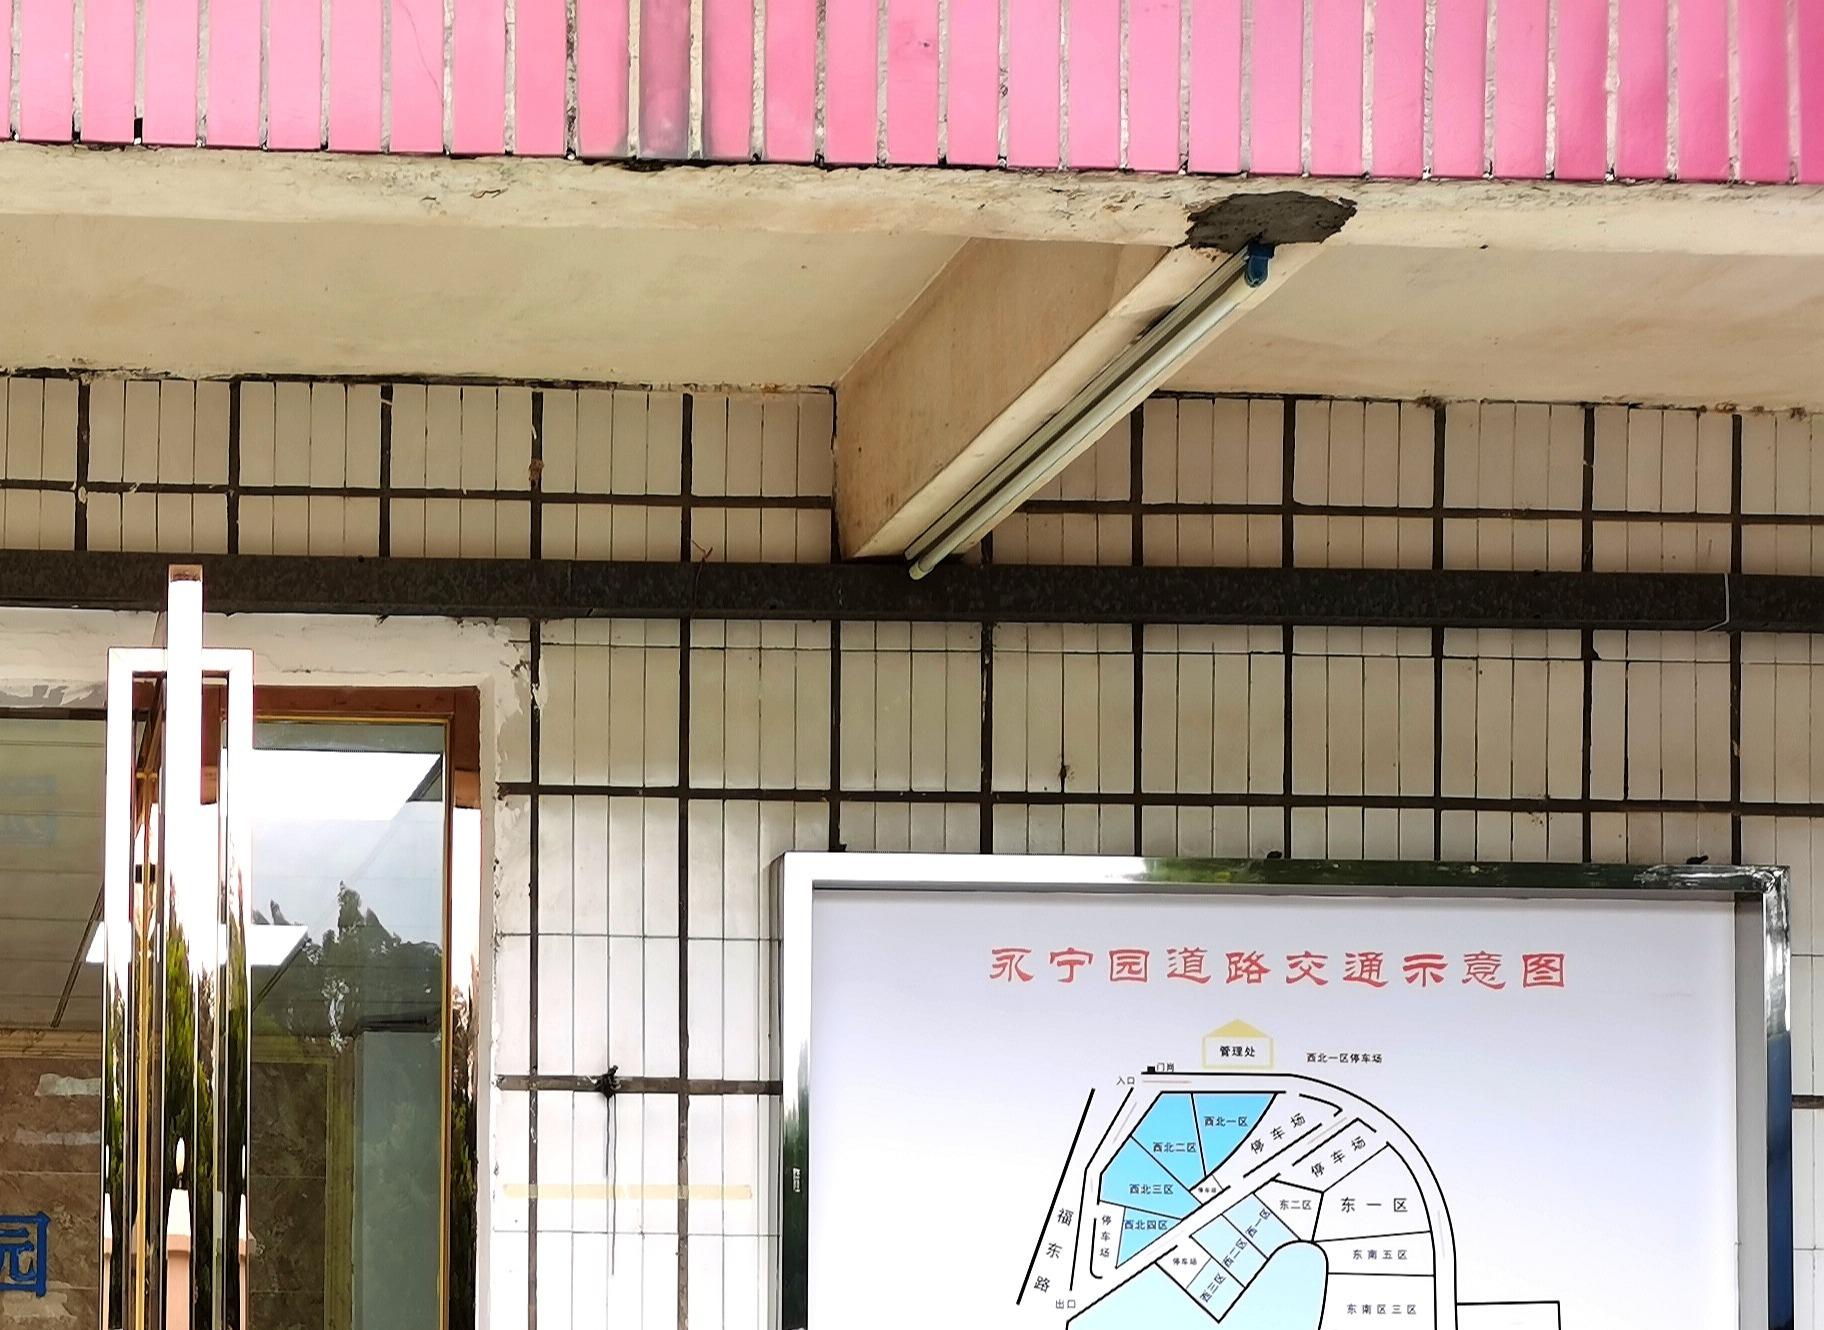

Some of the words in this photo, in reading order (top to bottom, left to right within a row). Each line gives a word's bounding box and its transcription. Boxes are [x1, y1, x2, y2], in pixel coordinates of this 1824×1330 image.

[989, 946, 1568, 989] 永宁园道路交通示意图
[1219, 1045, 1256, 1058] 管理处
[1306, 1053, 1382, 1064] 西北一区停车场
[1116, 1075, 1135, 1086] 入口
[1204, 1116, 1248, 1128] 西北一区
[1250, 1112, 1306, 1154] 停车场
[1153, 1141, 1197, 1153] 西北二区
[1311, 1136, 1366, 1177] 停车场
[1129, 1183, 1173, 1195] 西北三区
[1279, 1199, 1312, 1211] 东二区
[1341, 1197, 1407, 1212] 东一区
[1124, 1219, 1168, 1231] 西北四区
[1100, 1215, 1111, 1258] 停车场
[1034, 1208, 1074, 1293] 福东路
[1353, 1249, 1407, 1260] 东南五区
[1056, 1299, 1076, 1309] 出口
[1346, 1304, 1417, 1315] 东南区三区
